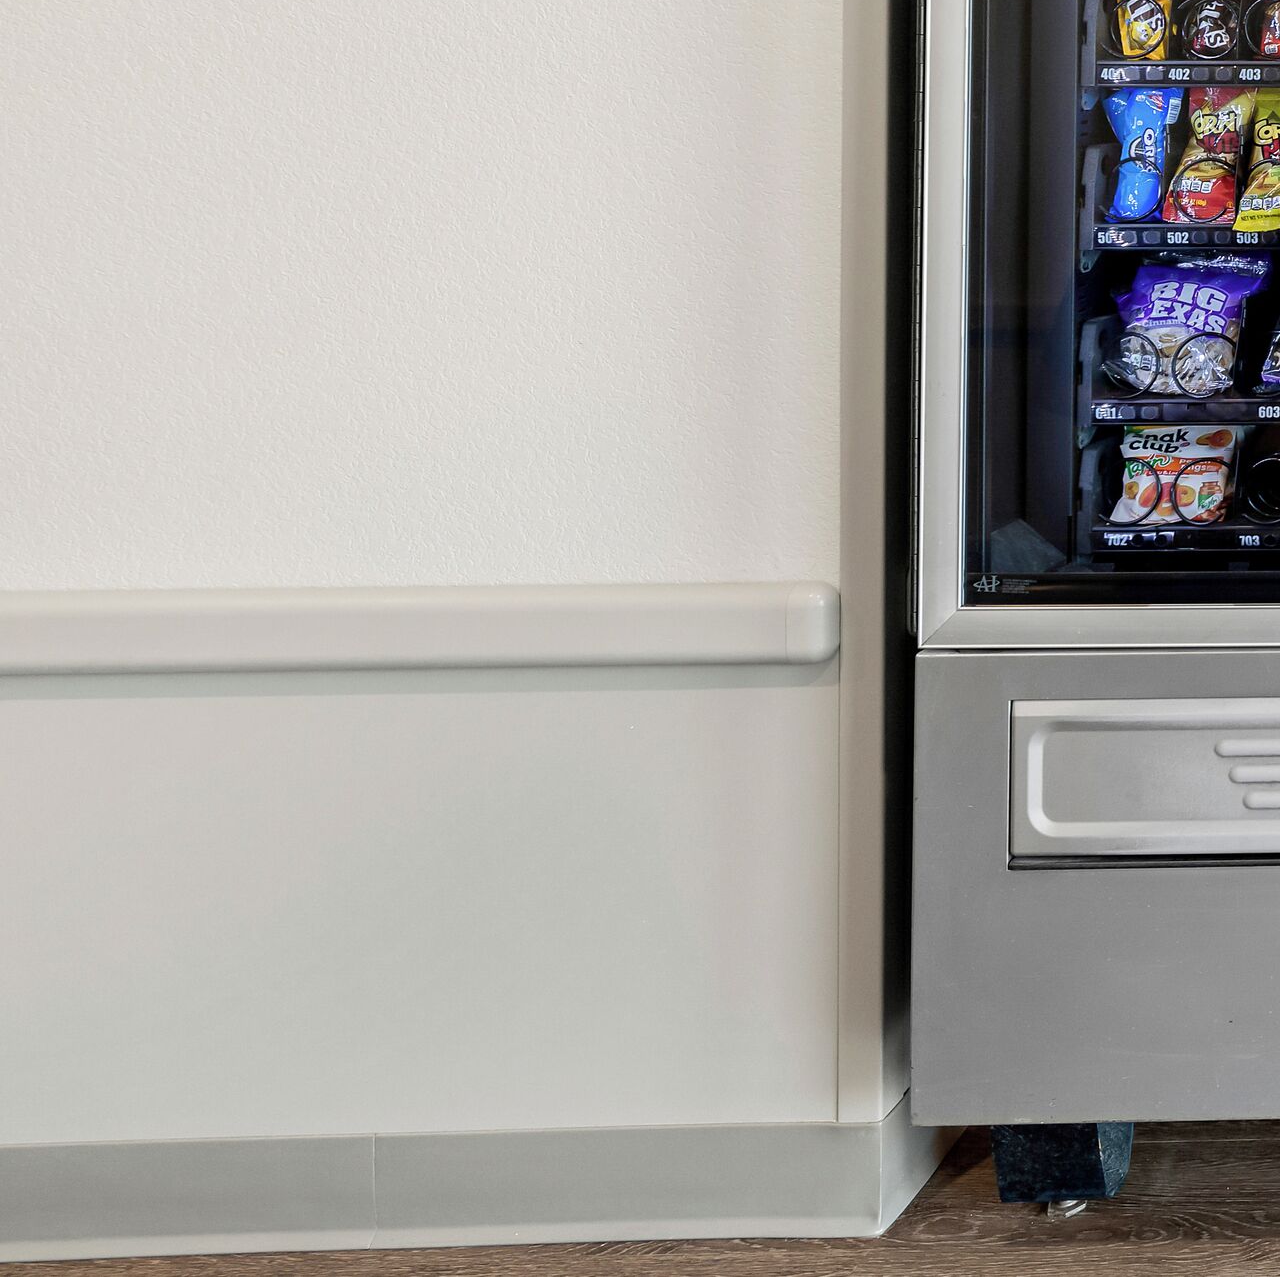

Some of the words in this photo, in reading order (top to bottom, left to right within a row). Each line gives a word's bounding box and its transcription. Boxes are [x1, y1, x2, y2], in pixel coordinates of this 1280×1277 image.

[1168, 68, 1190, 81] 402
[1239, 68, 1261, 81] 403
[1167, 232, 1189, 244] 502
[1236, 232, 1259, 244] 503
[1151, 281, 1228, 312] BIG
[1258, 406, 1280, 418] 603
[1129, 439, 1180, 453] club
[1239, 535, 1261, 546] 703
